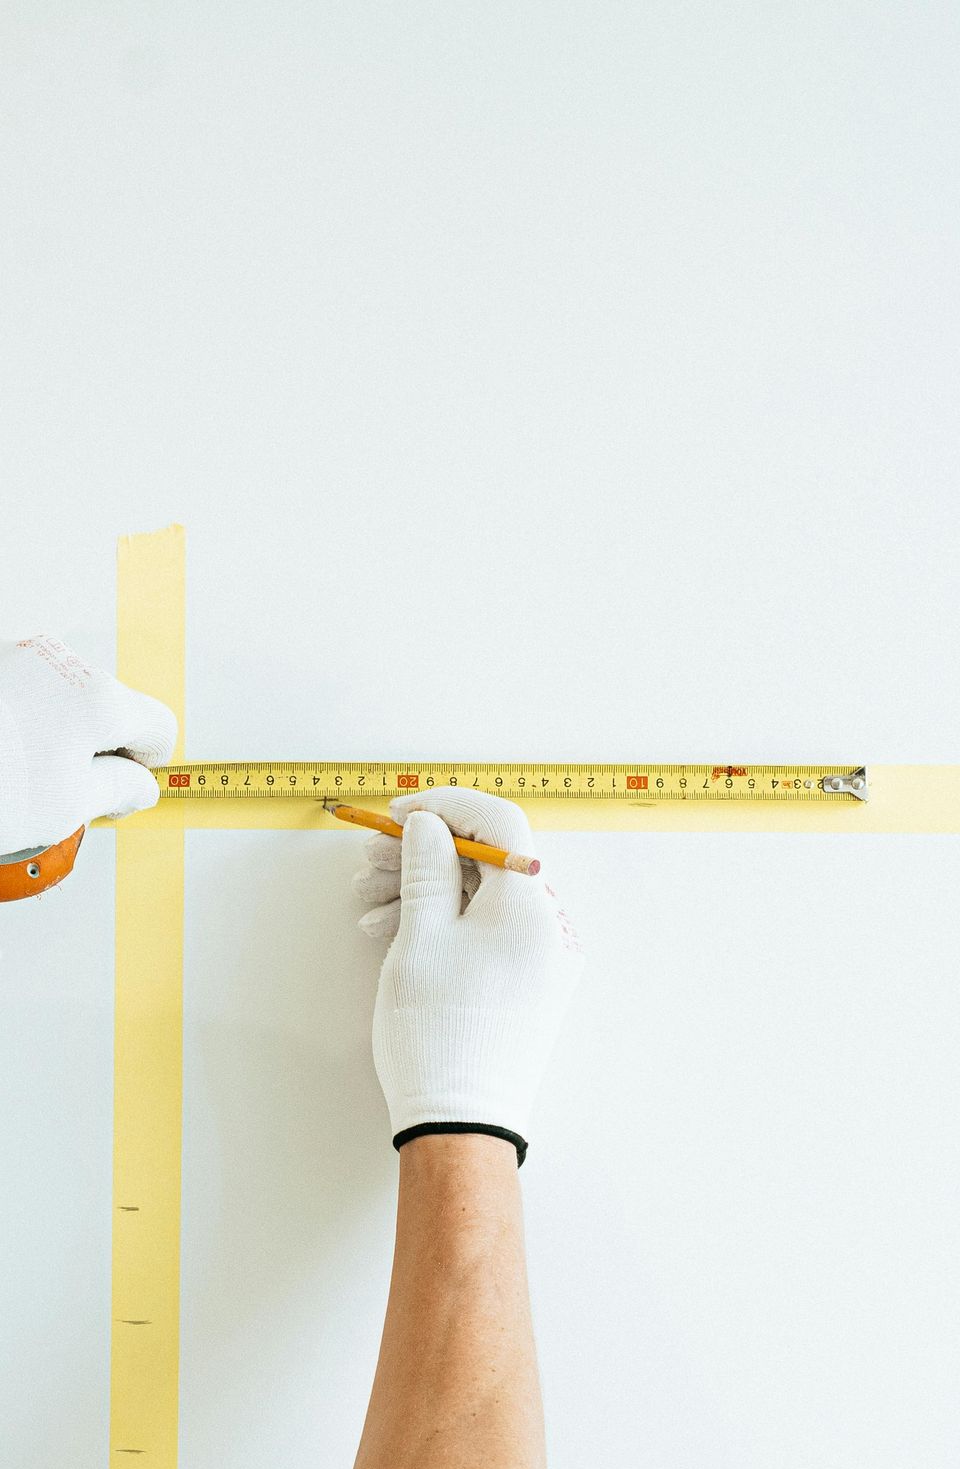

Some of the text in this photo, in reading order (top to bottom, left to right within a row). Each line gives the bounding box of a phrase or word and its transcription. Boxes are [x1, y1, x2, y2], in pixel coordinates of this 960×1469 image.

[170, 776, 189, 786] 30
[198, 775, 206, 785] 9
[221, 775, 229, 785] 8
[244, 775, 252, 785] 7
[266, 775, 274, 785] 6
[289, 776, 297, 785] 5
[313, 776, 320, 785] 4
[335, 776, 343, 785] 3
[358, 776, 365, 786] 2
[399, 777, 417, 787] 20
[426, 777, 434, 786] 9
[450, 777, 457, 786] 8
[473, 777, 480, 787] 7
[495, 777, 503, 787] 6
[518, 777, 525, 787] 5
[541, 778, 549, 787] 4
[564, 778, 571, 787] 3
[588, 778, 595, 787] 2
[629, 778, 647, 788] 10
[657, 778, 664, 788] 9
[680, 778, 687, 788] 8
[703, 779, 710, 788] 7
[725, 779, 732, 788] 6
[748, 779, 755, 788] 5
[772, 779, 779, 788] 4
[794, 779, 801, 788] 3
